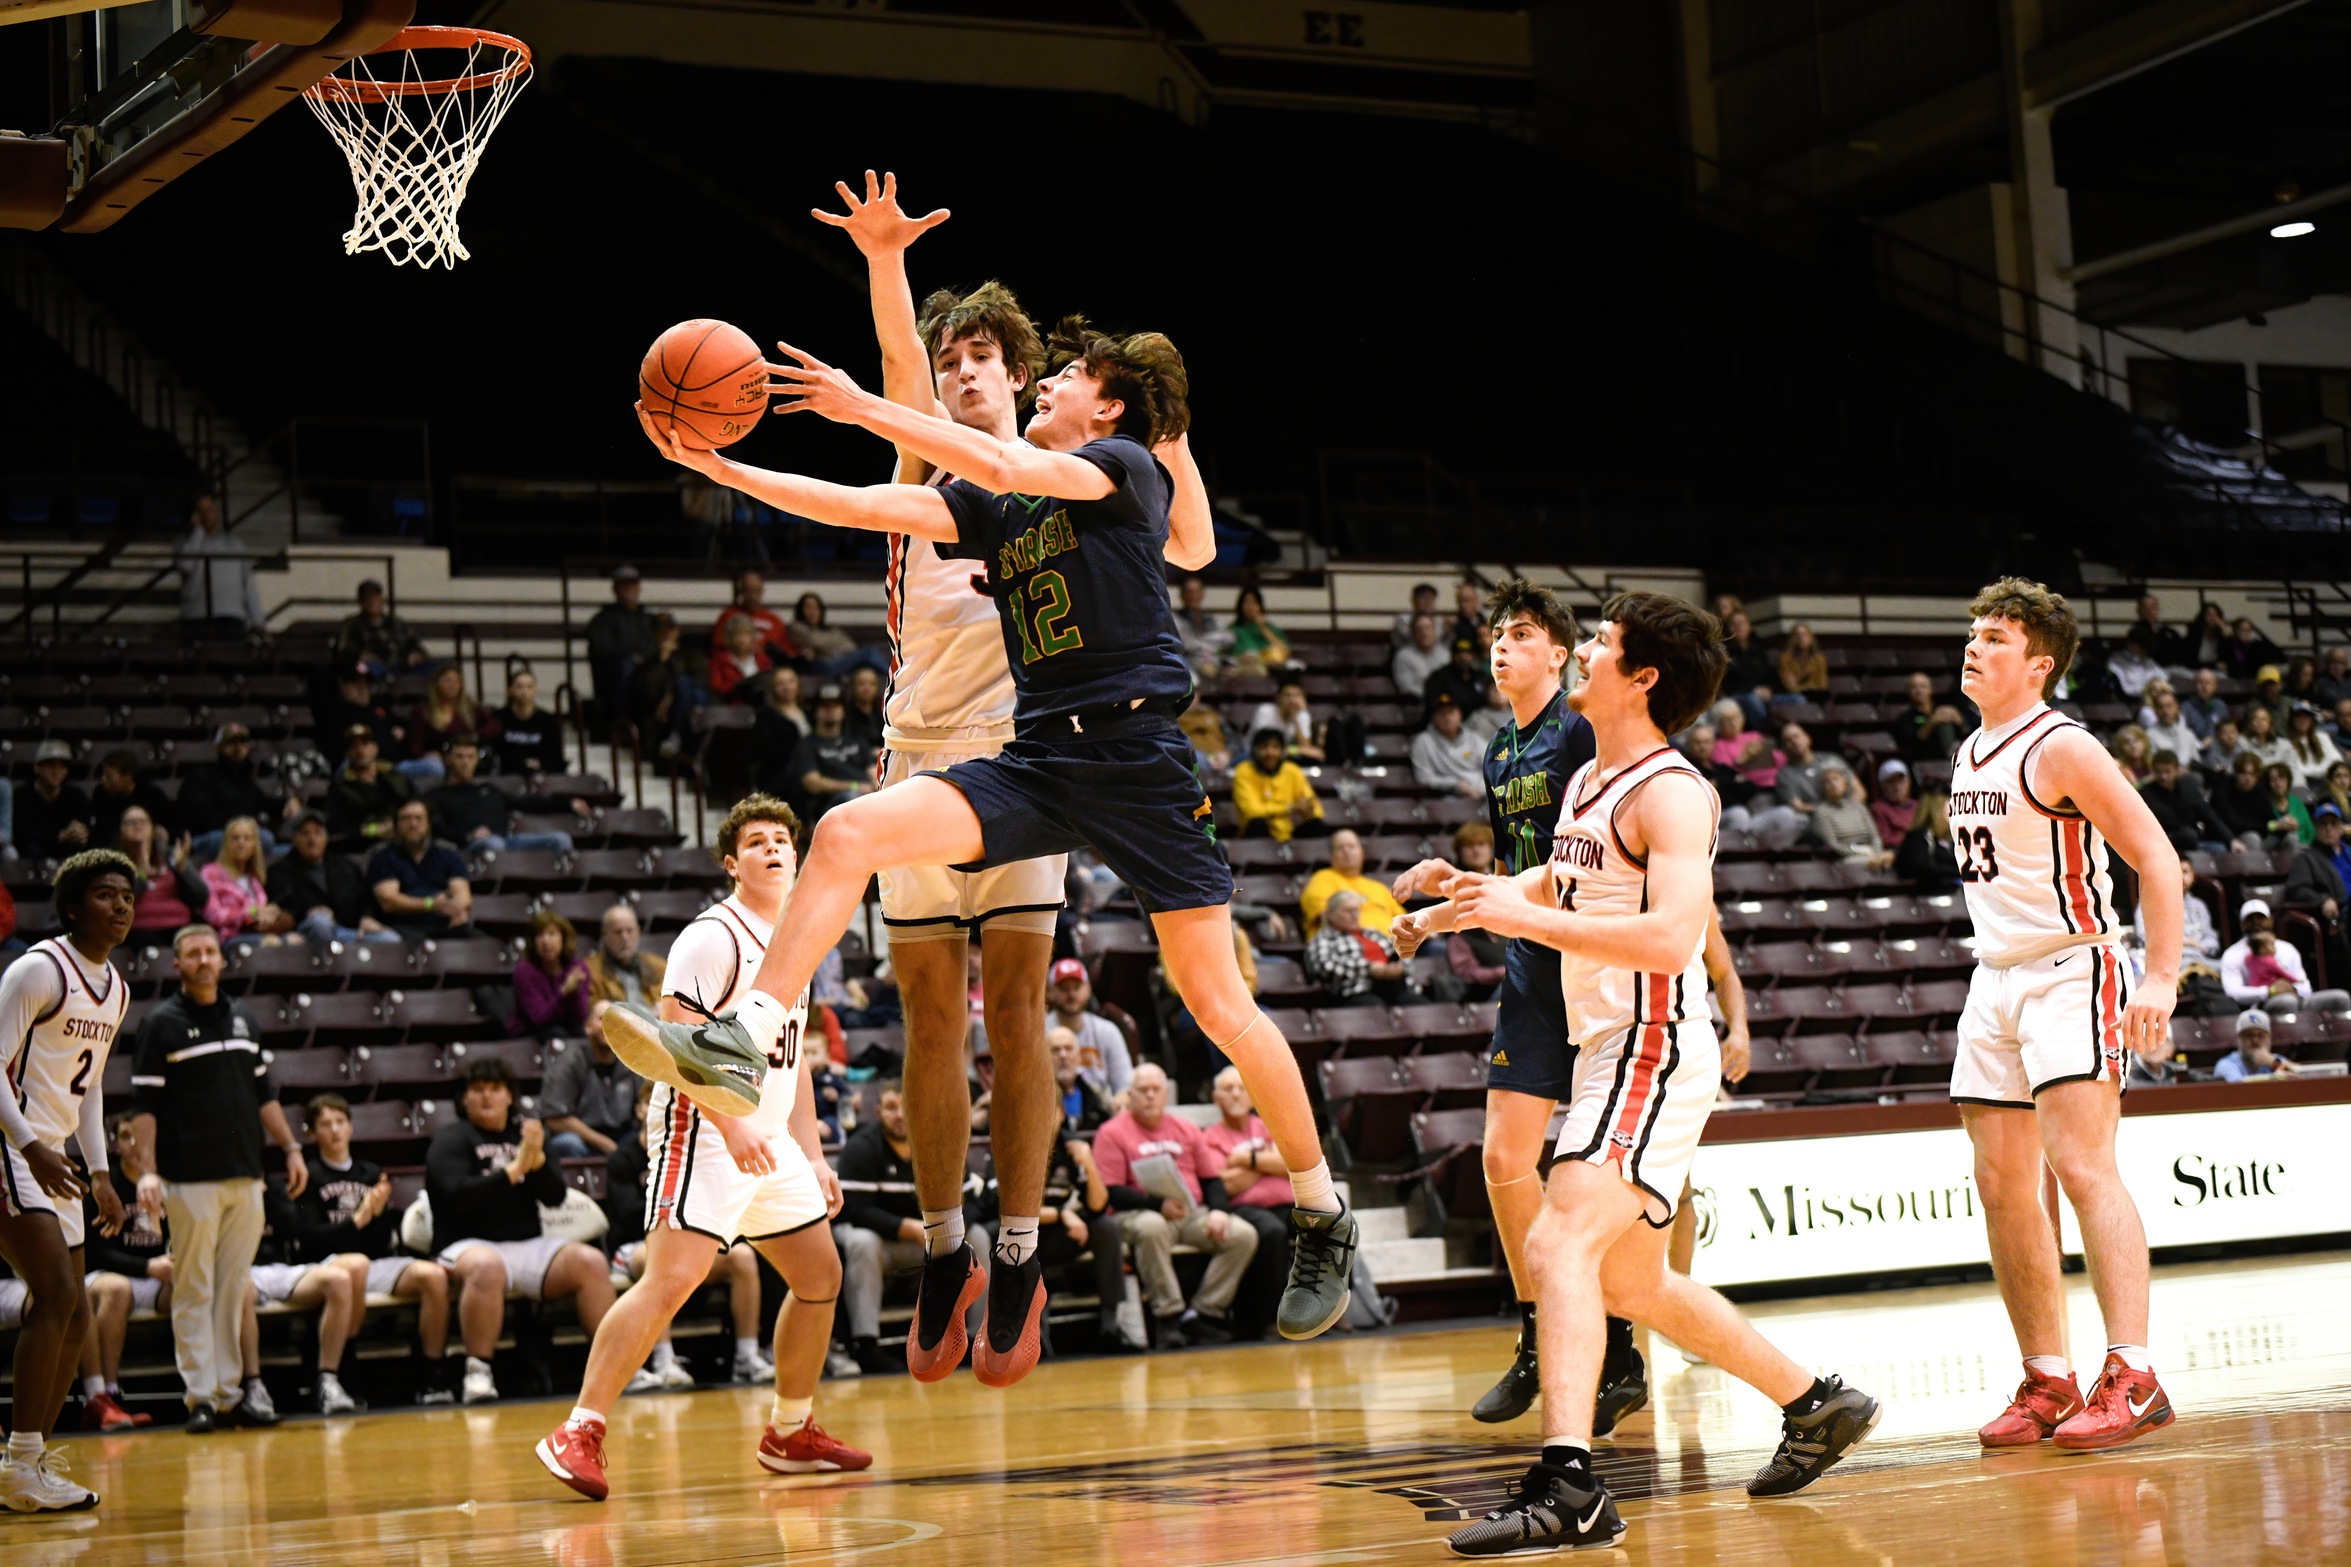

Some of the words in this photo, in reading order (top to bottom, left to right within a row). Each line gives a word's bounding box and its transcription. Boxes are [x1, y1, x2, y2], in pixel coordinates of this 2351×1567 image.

[1304, 11, 1364, 46] EE
[1009, 569, 1084, 666] 12
[1553, 834, 1604, 871] TOCKTON
[1957, 825, 1999, 883] 23
[63, 1017, 115, 1044] STOCKTO
[767, 1019, 799, 1070] 30
[70, 1047, 93, 1097] 2
[1747, 1175, 1974, 1240] Missouri
[2173, 1153, 2287, 1208] State
